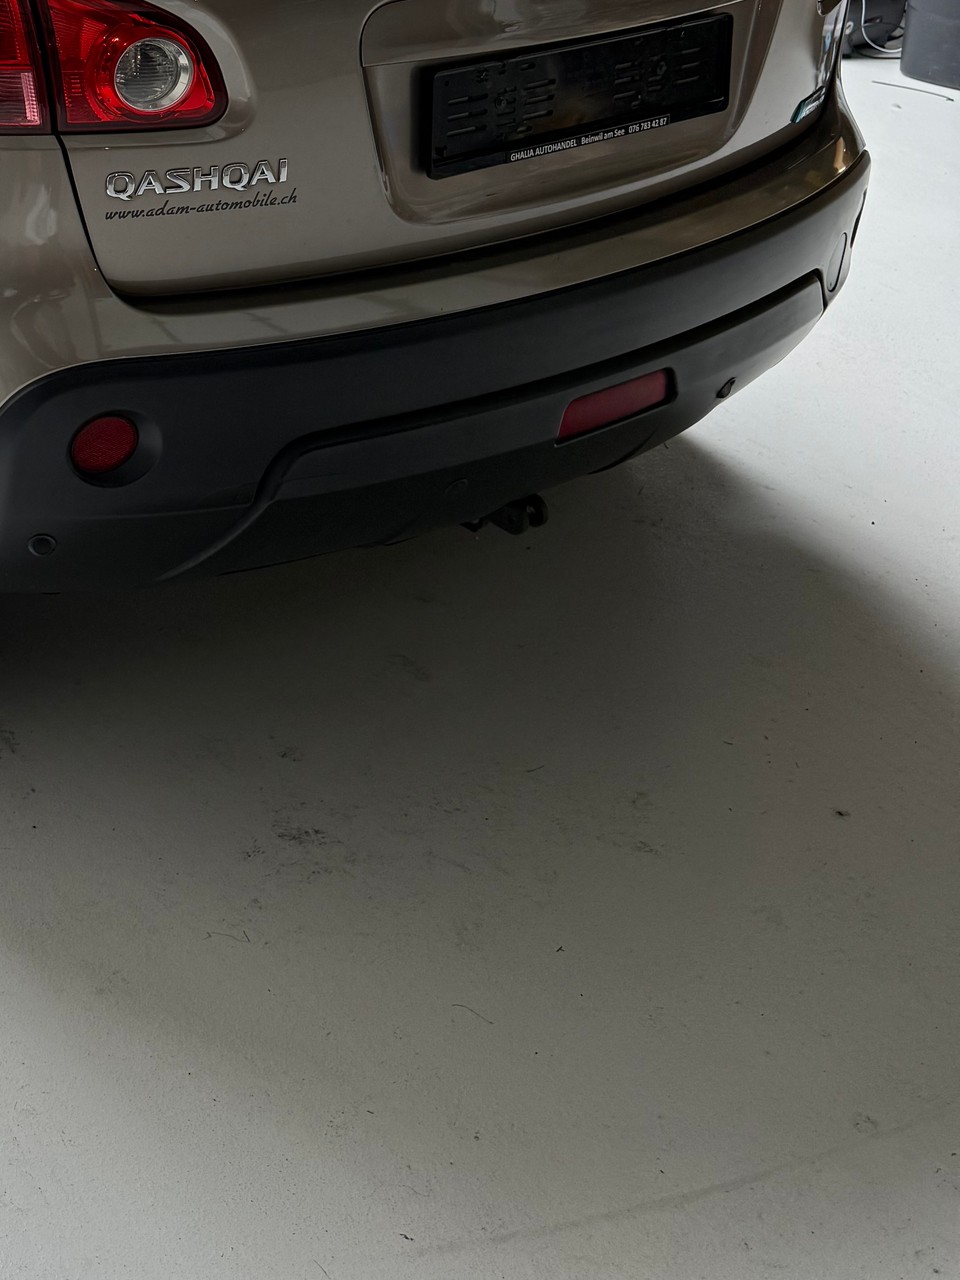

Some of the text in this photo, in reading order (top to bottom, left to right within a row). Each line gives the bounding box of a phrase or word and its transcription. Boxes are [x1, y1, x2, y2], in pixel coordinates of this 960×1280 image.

[510, 118, 667, 161] GHALIA AUTOHANDEL Beinwil am See 076 783 42 87
[106, 158, 288, 201] QASHQAI
[105, 187, 298, 221] www.adam-automobile.ch
